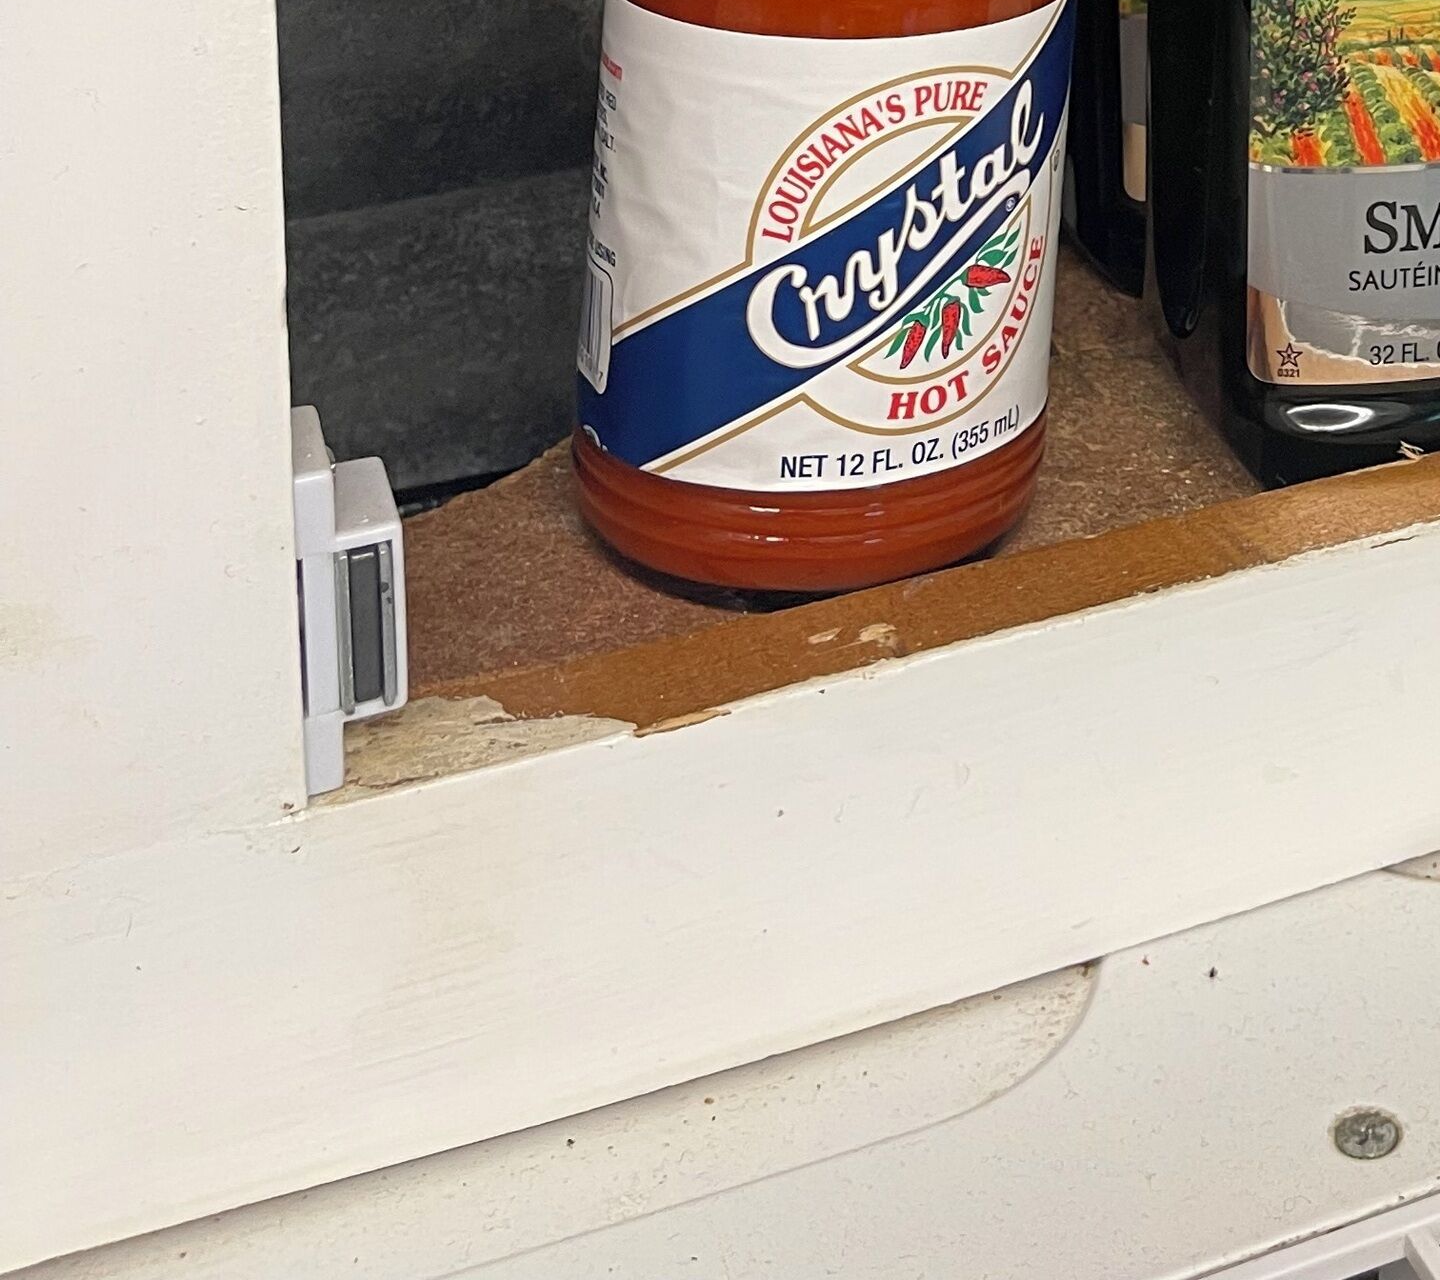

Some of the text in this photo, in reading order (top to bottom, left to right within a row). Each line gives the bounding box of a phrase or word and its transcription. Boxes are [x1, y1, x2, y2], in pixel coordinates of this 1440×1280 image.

[746, 78, 1044, 368] Crystal
[762, 79, 988, 243] LOUISIANA'S PURE
[887, 234, 1043, 421] HOT SAUCE
[1369, 344, 1395, 365] 32
[1401, 343, 1430, 363] FL.
[780, 403, 1021, 480] NET 12 FL. OZ. (355 mL)
